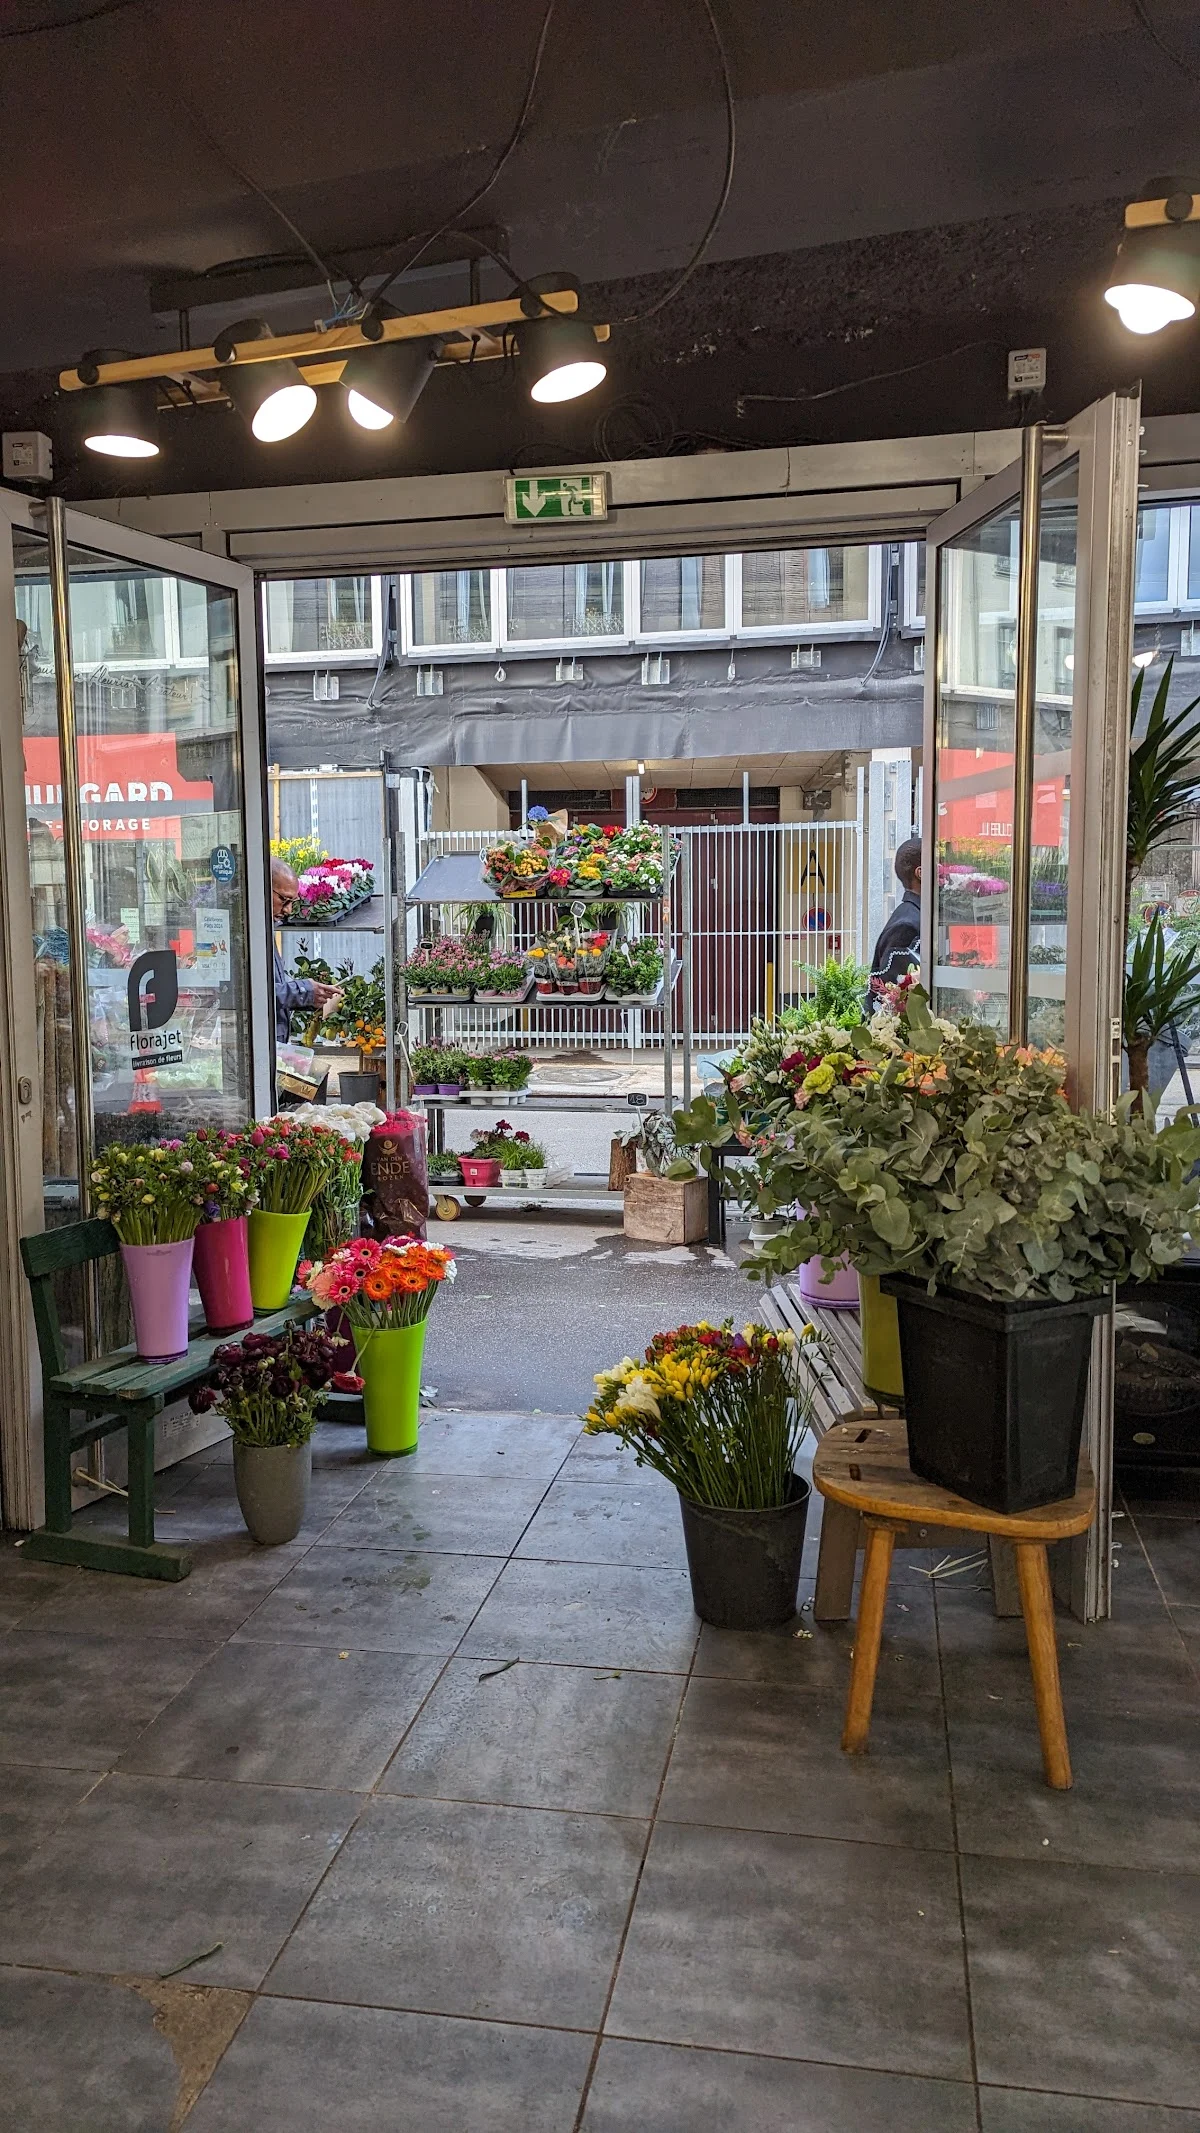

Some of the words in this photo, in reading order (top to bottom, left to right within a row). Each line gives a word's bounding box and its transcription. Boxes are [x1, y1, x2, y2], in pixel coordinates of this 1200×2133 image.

[800, 849, 826, 887] A
[130, 1029, 182, 1051] florajet
[132, 1058, 157, 1068] livraison
[157, 1055, 165, 1064] de
[165, 1053, 181, 1062] fleurs
[370, 1160, 410, 1176] ENDE
